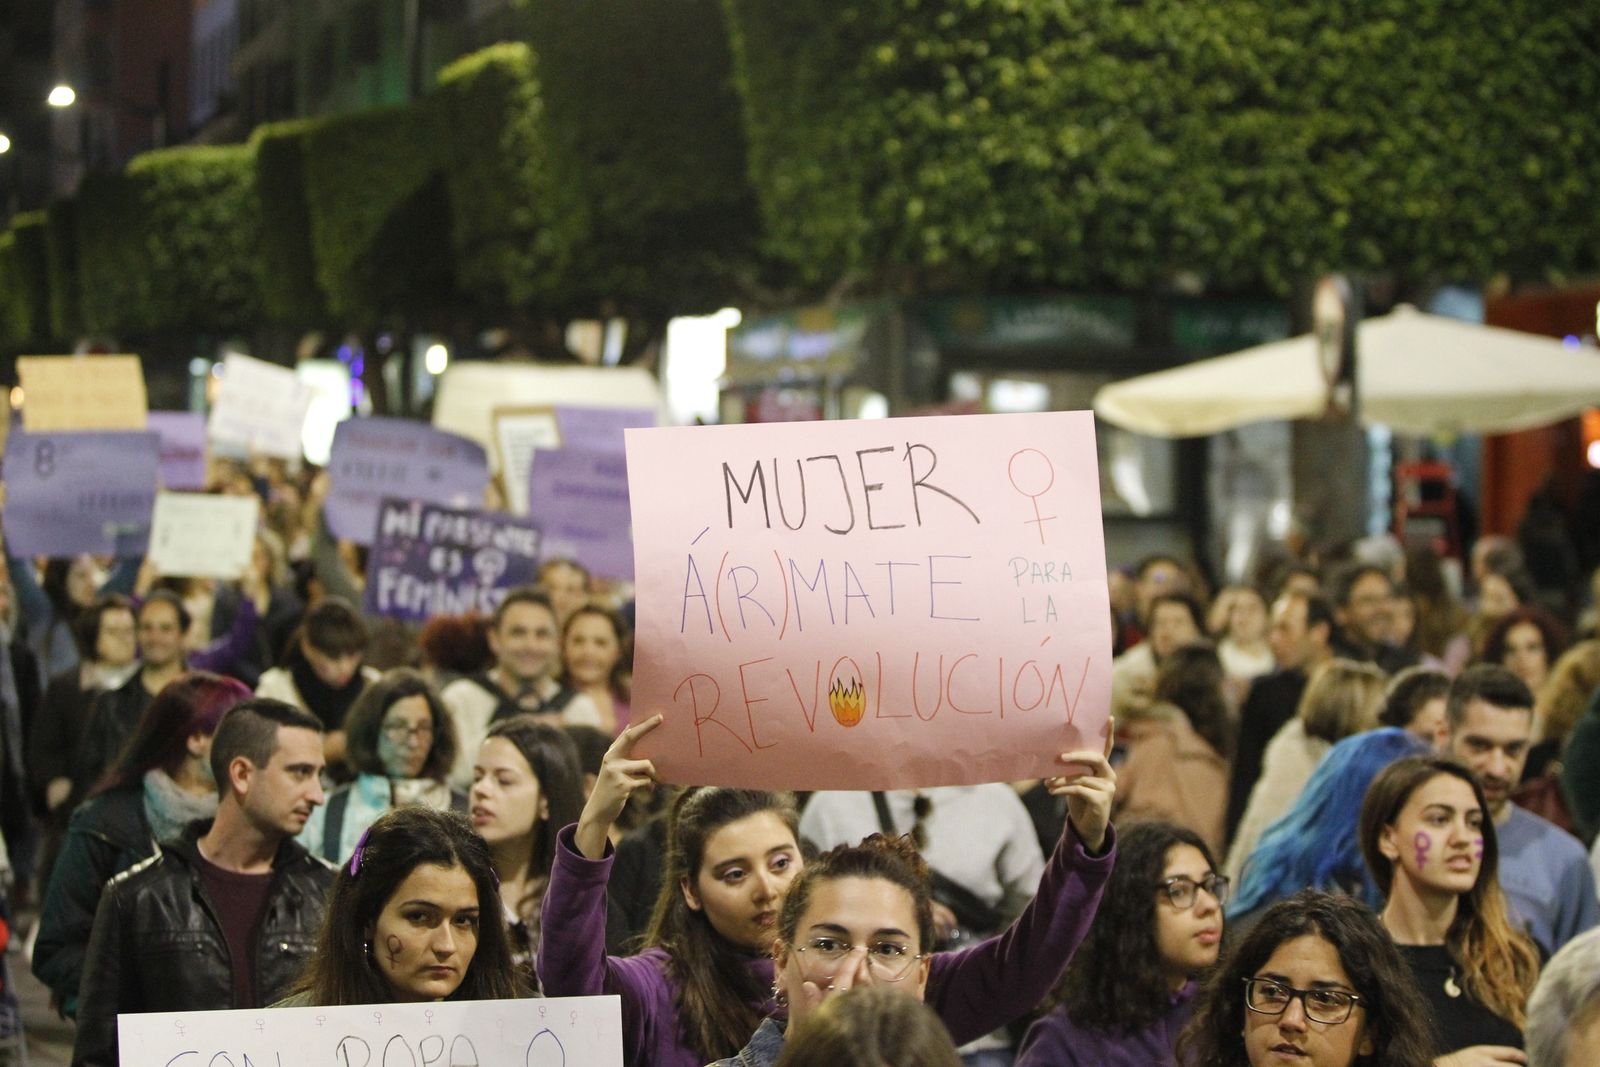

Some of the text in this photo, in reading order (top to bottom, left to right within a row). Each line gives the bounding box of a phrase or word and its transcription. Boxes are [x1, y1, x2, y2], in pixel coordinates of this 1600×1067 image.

[721, 441, 981, 536] MUJER
[680, 526, 981, 642] Á(R)MATE
[1007, 556, 1074, 587] PARA
[1021, 594, 1059, 624] LA
[673, 636, 1091, 758] REVOLUCIÓN
